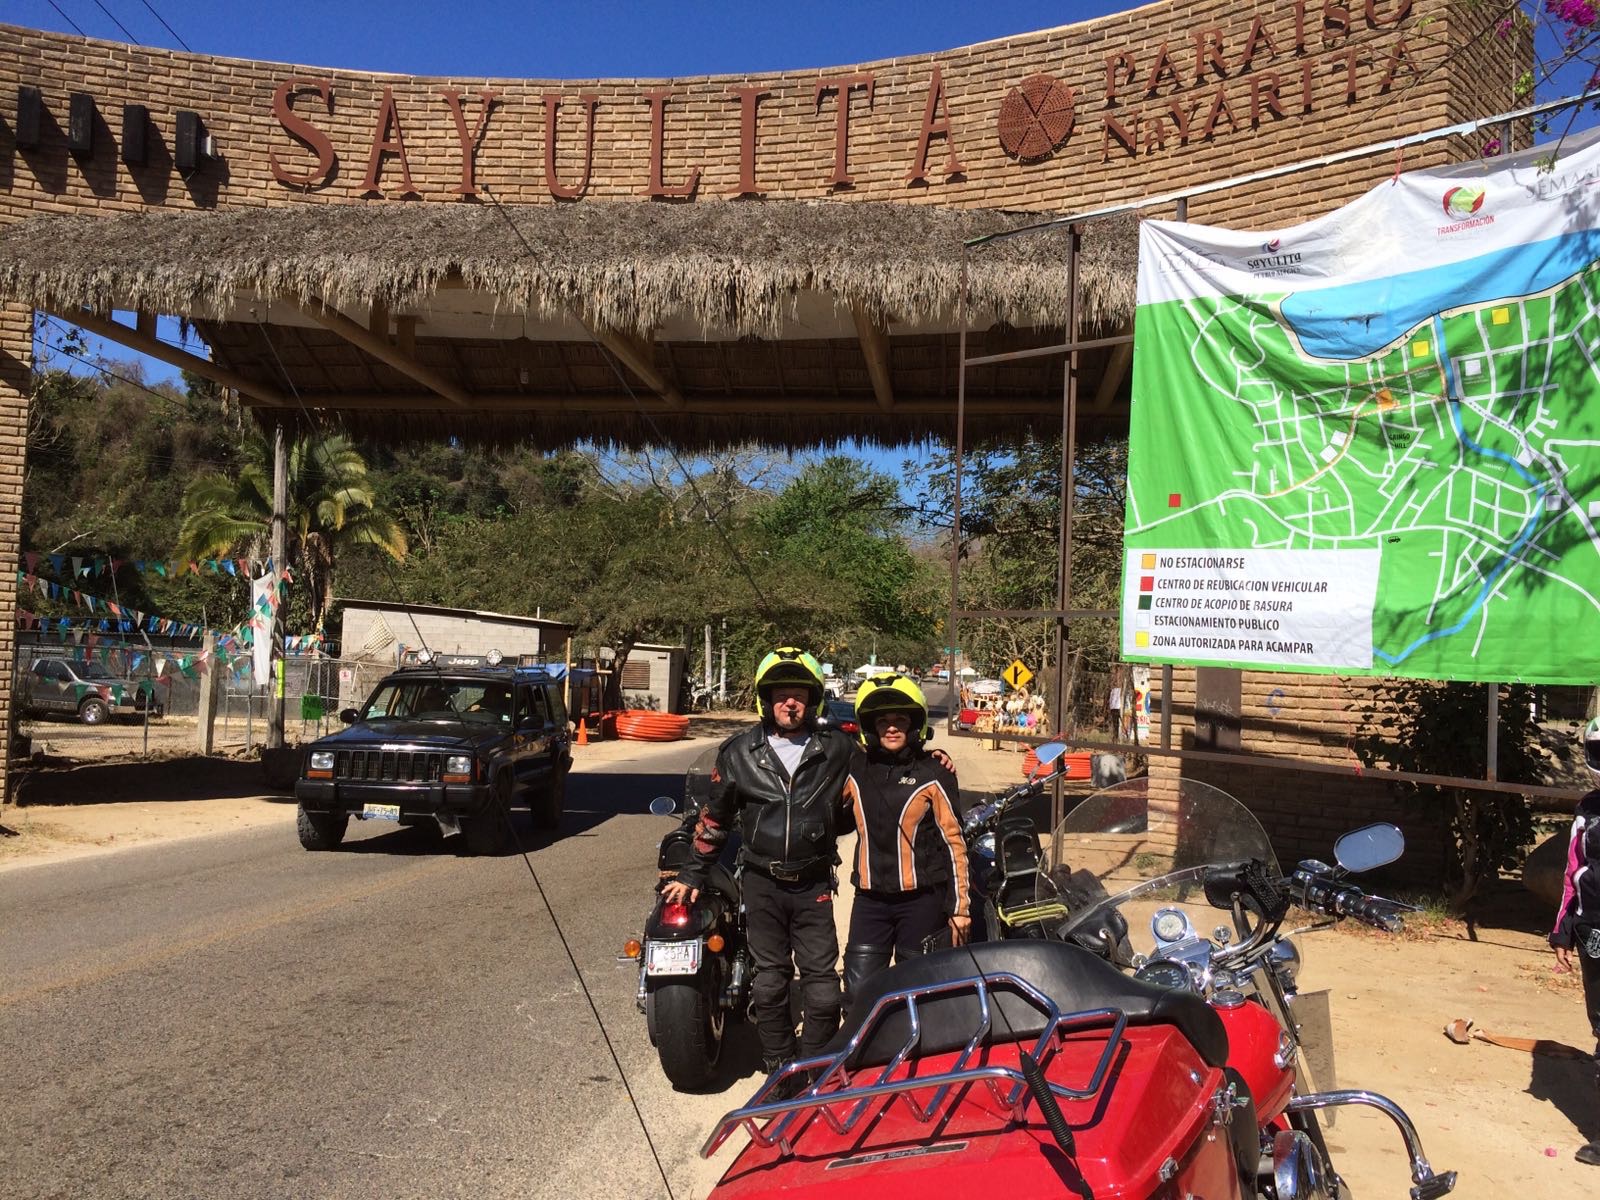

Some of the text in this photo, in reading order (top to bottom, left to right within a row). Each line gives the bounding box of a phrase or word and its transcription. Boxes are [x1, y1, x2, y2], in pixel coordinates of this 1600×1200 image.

[269, 64, 966, 198] SAYULITA
[1437, 215, 1495, 236] TRANSFORMACIÓN
[1160, 557, 1245, 569] NO ESTACIONARSE
[1158, 579, 1328, 593] CENTRO DE REUBICACION VEHICULAR
[1155, 597, 1293, 612] CENTRO DE ACOPIO DE BASURA
[1155, 615, 1280, 631] ESTACIONAMIENTO PUBLICO
[1152, 636, 1314, 654] ZONA AUTORIZADA PARA ACAMPAR
[447, 657, 480, 666] Jeep
